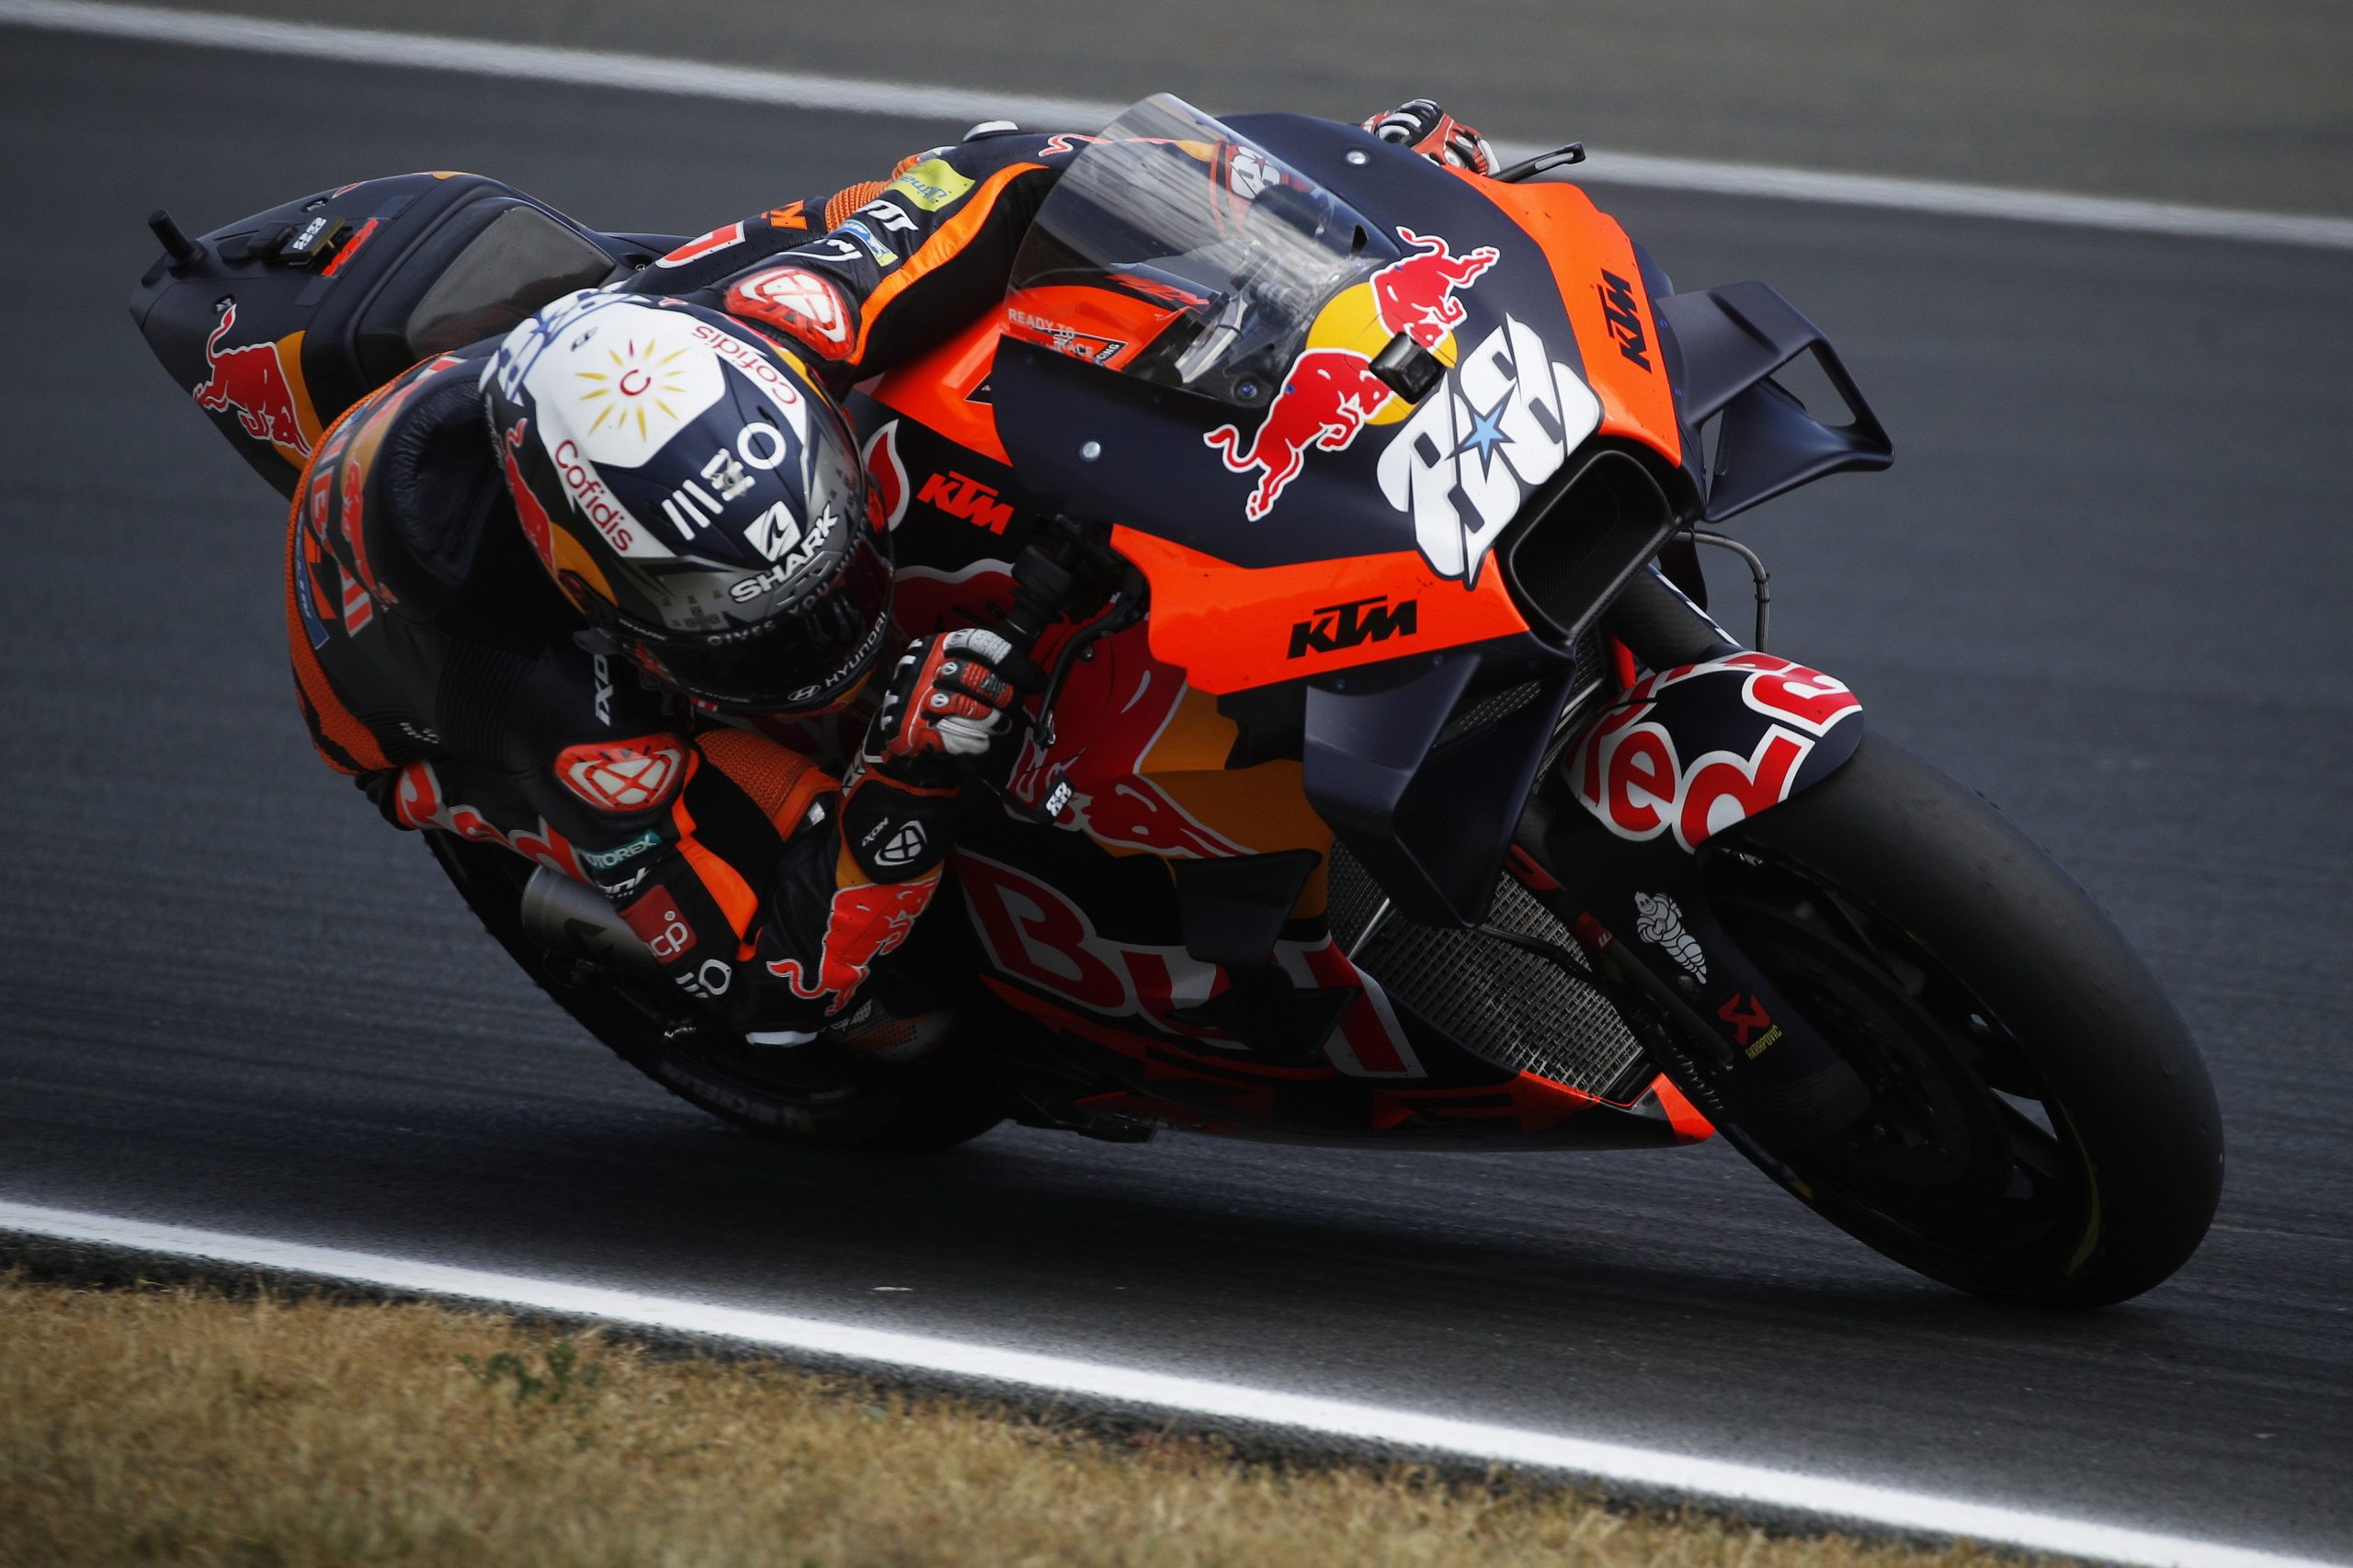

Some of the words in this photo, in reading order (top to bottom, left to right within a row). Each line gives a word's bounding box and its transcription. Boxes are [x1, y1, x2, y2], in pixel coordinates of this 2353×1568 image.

[1007, 306, 1055, 332] READY
[1597, 267, 1653, 374] KTM
[692, 323, 798, 406] Cofidis
[1376, 311, 1604, 590] 88
[554, 438, 635, 553] Cofidis
[915, 470, 1016, 537] KTM
[729, 502, 839, 604] SHARK
[824, 610, 888, 687] HYUNDAI
[1287, 595, 1418, 660] KTM
[862, 817, 890, 848] IXON
[1046, 781, 1074, 817] 88
[646, 921, 689, 958] cp
